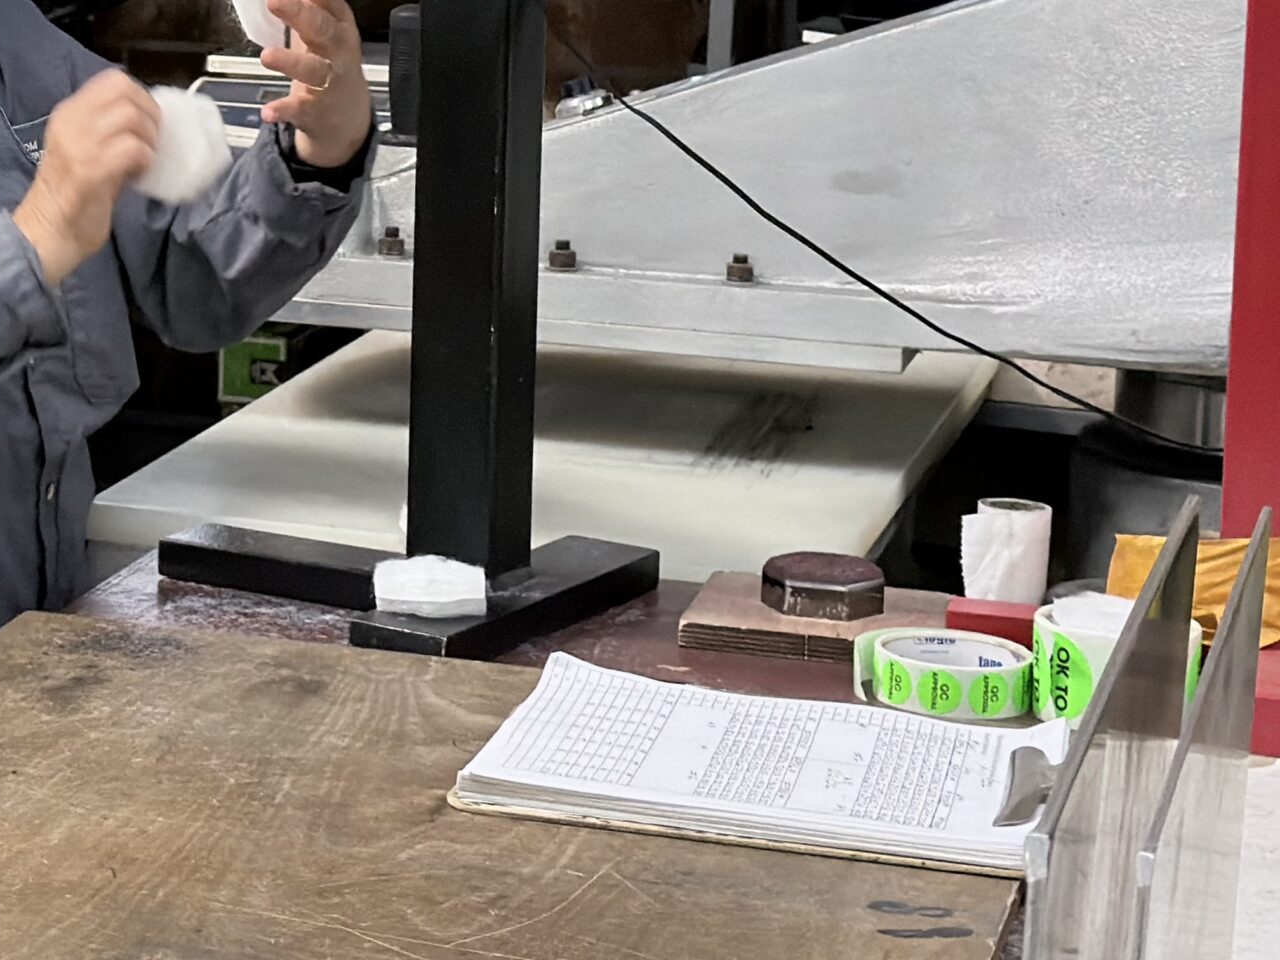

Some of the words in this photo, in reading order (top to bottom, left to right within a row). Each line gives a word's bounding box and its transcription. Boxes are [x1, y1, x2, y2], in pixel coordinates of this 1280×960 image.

[1056, 647, 1070, 679] OK
[894, 674, 902, 692] QC
[930, 671, 939, 710] APPROVAL
[939, 683, 950, 701] QC
[982, 674, 990, 714] APPROVAL
[990, 685, 999, 703] QC
[1054, 684, 1069, 712] TO
